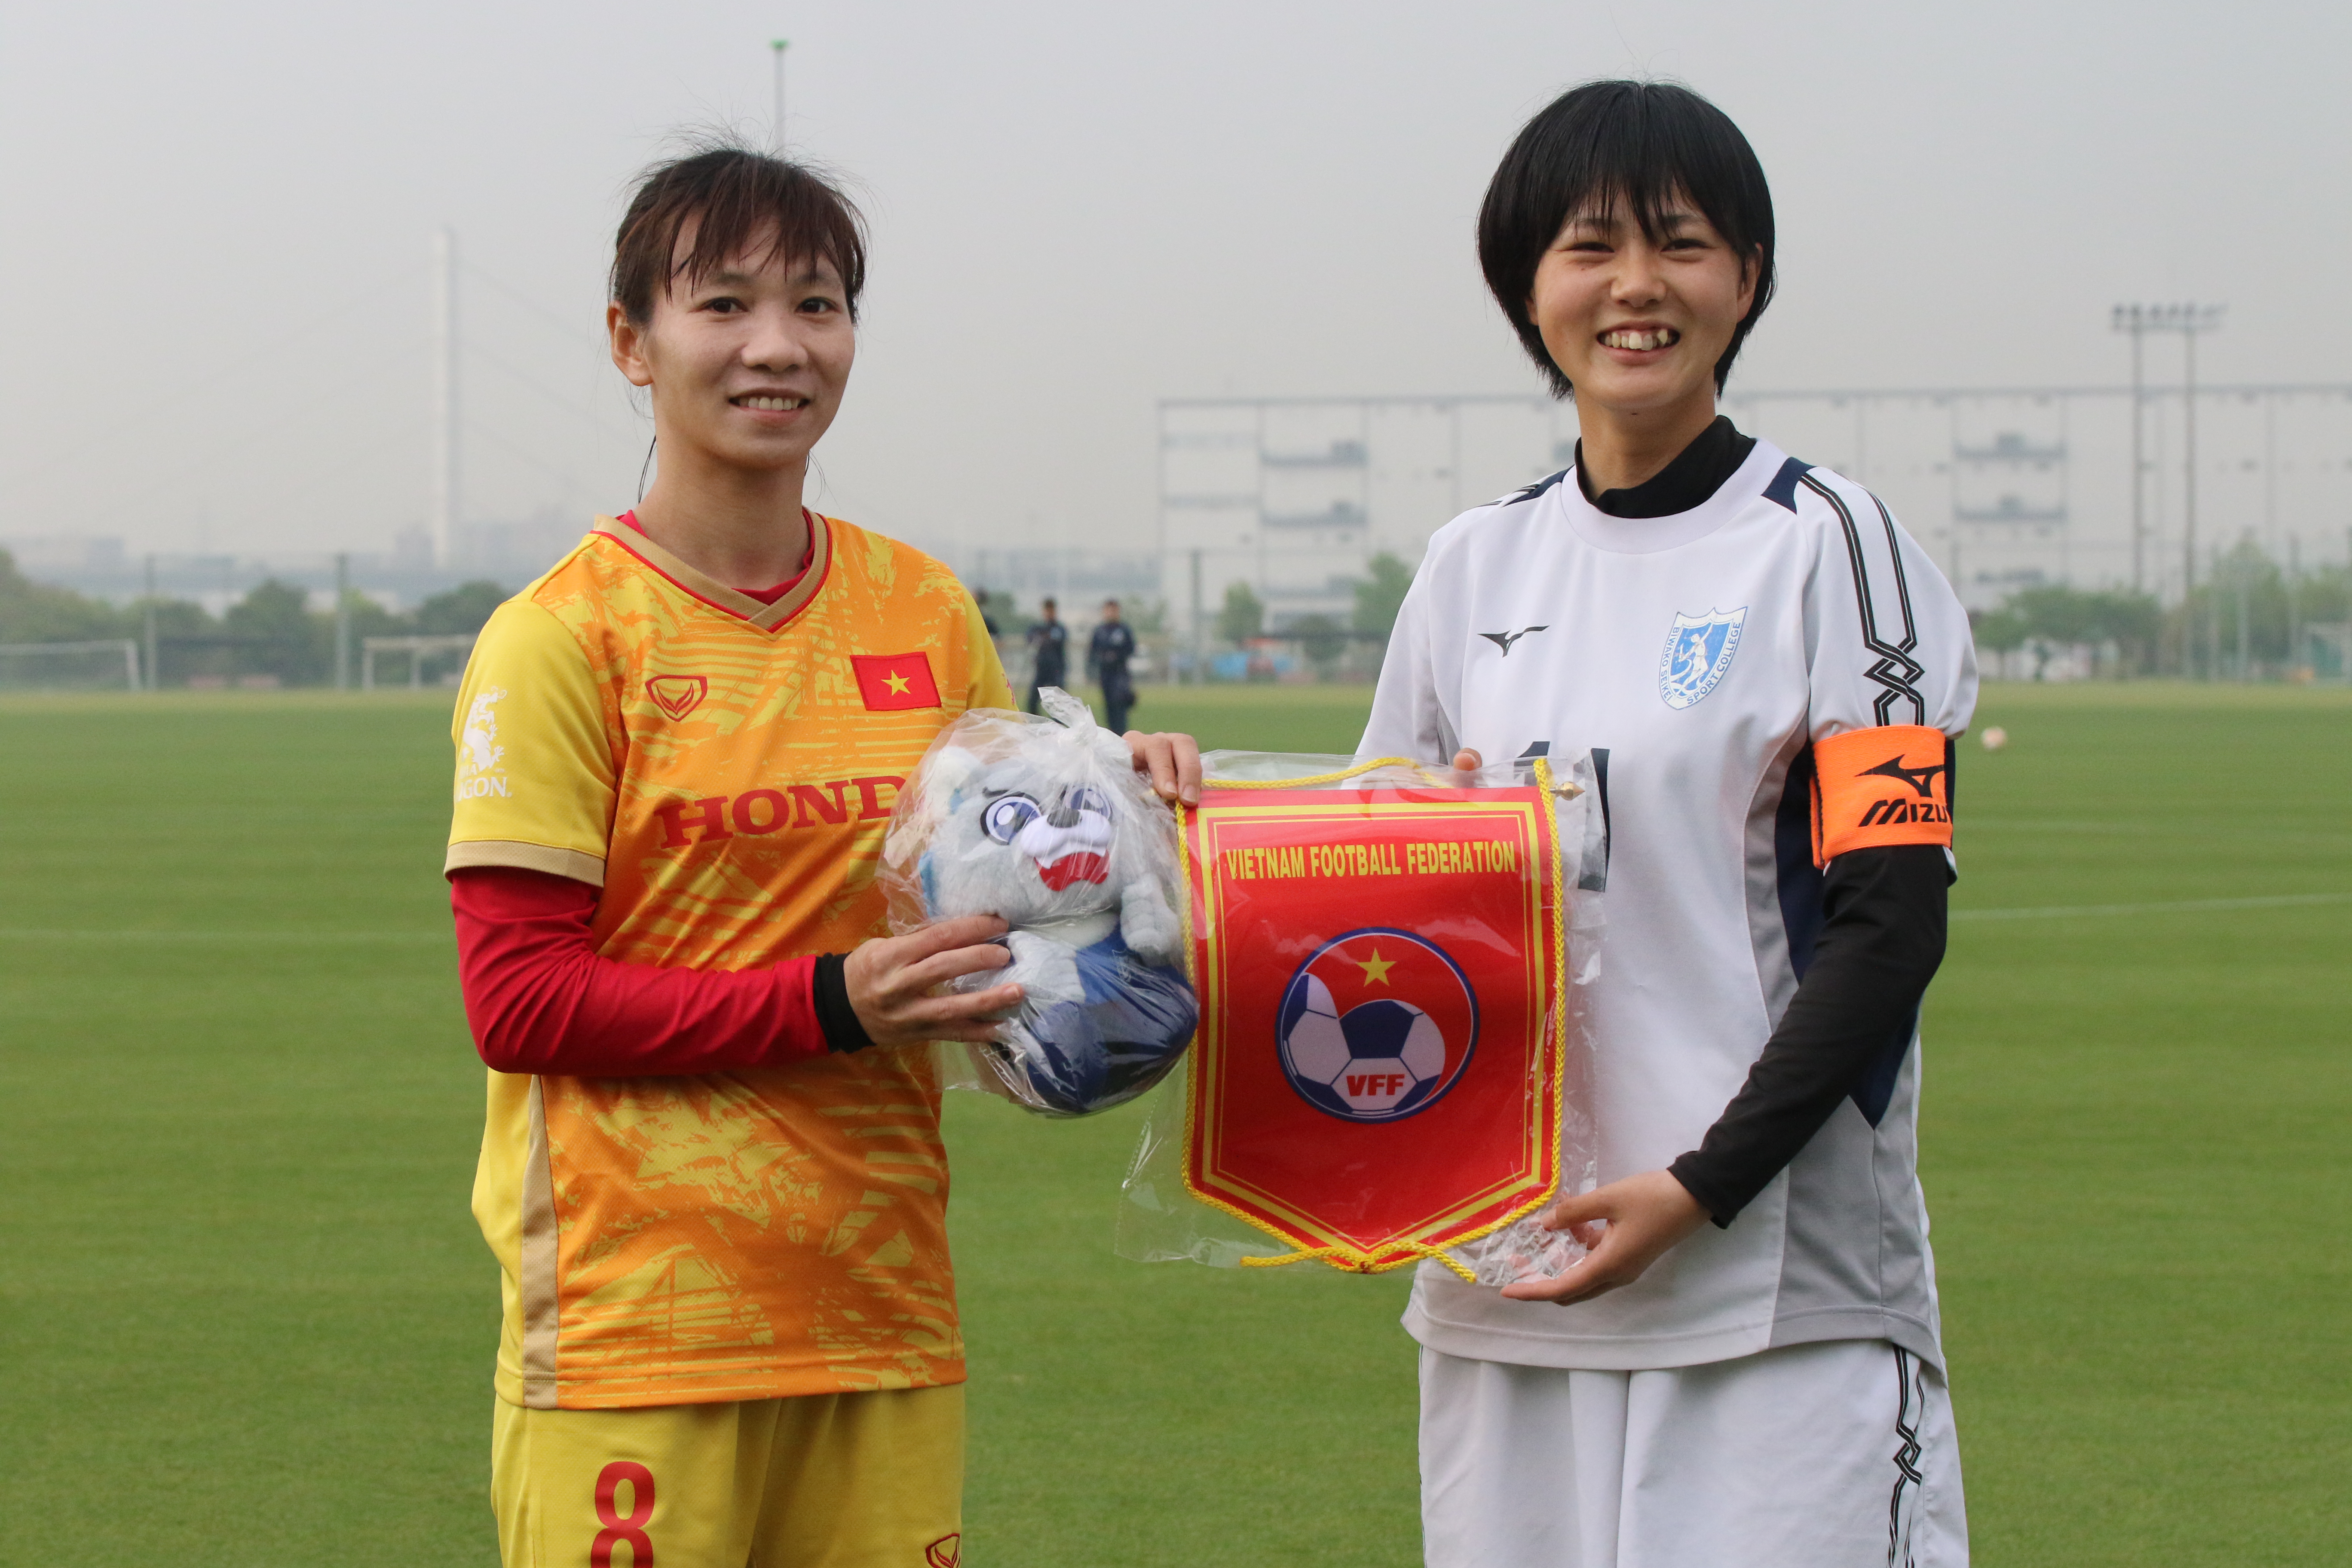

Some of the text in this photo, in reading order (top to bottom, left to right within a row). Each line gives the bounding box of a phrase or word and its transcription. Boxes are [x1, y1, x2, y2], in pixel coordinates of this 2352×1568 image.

[1661, 627, 1680, 701] BIWAKO SEIKEI
[1687, 622, 1741, 704] SPORT COLLEGE
[653, 775, 912, 849] HOND
[1859, 798, 1947, 827] MIZU
[1226, 840, 1516, 879] VIETNAM FOOTBALL FEDERATION
[1346, 1074, 1406, 1097] VFF
[590, 1461, 655, 1568] 8
